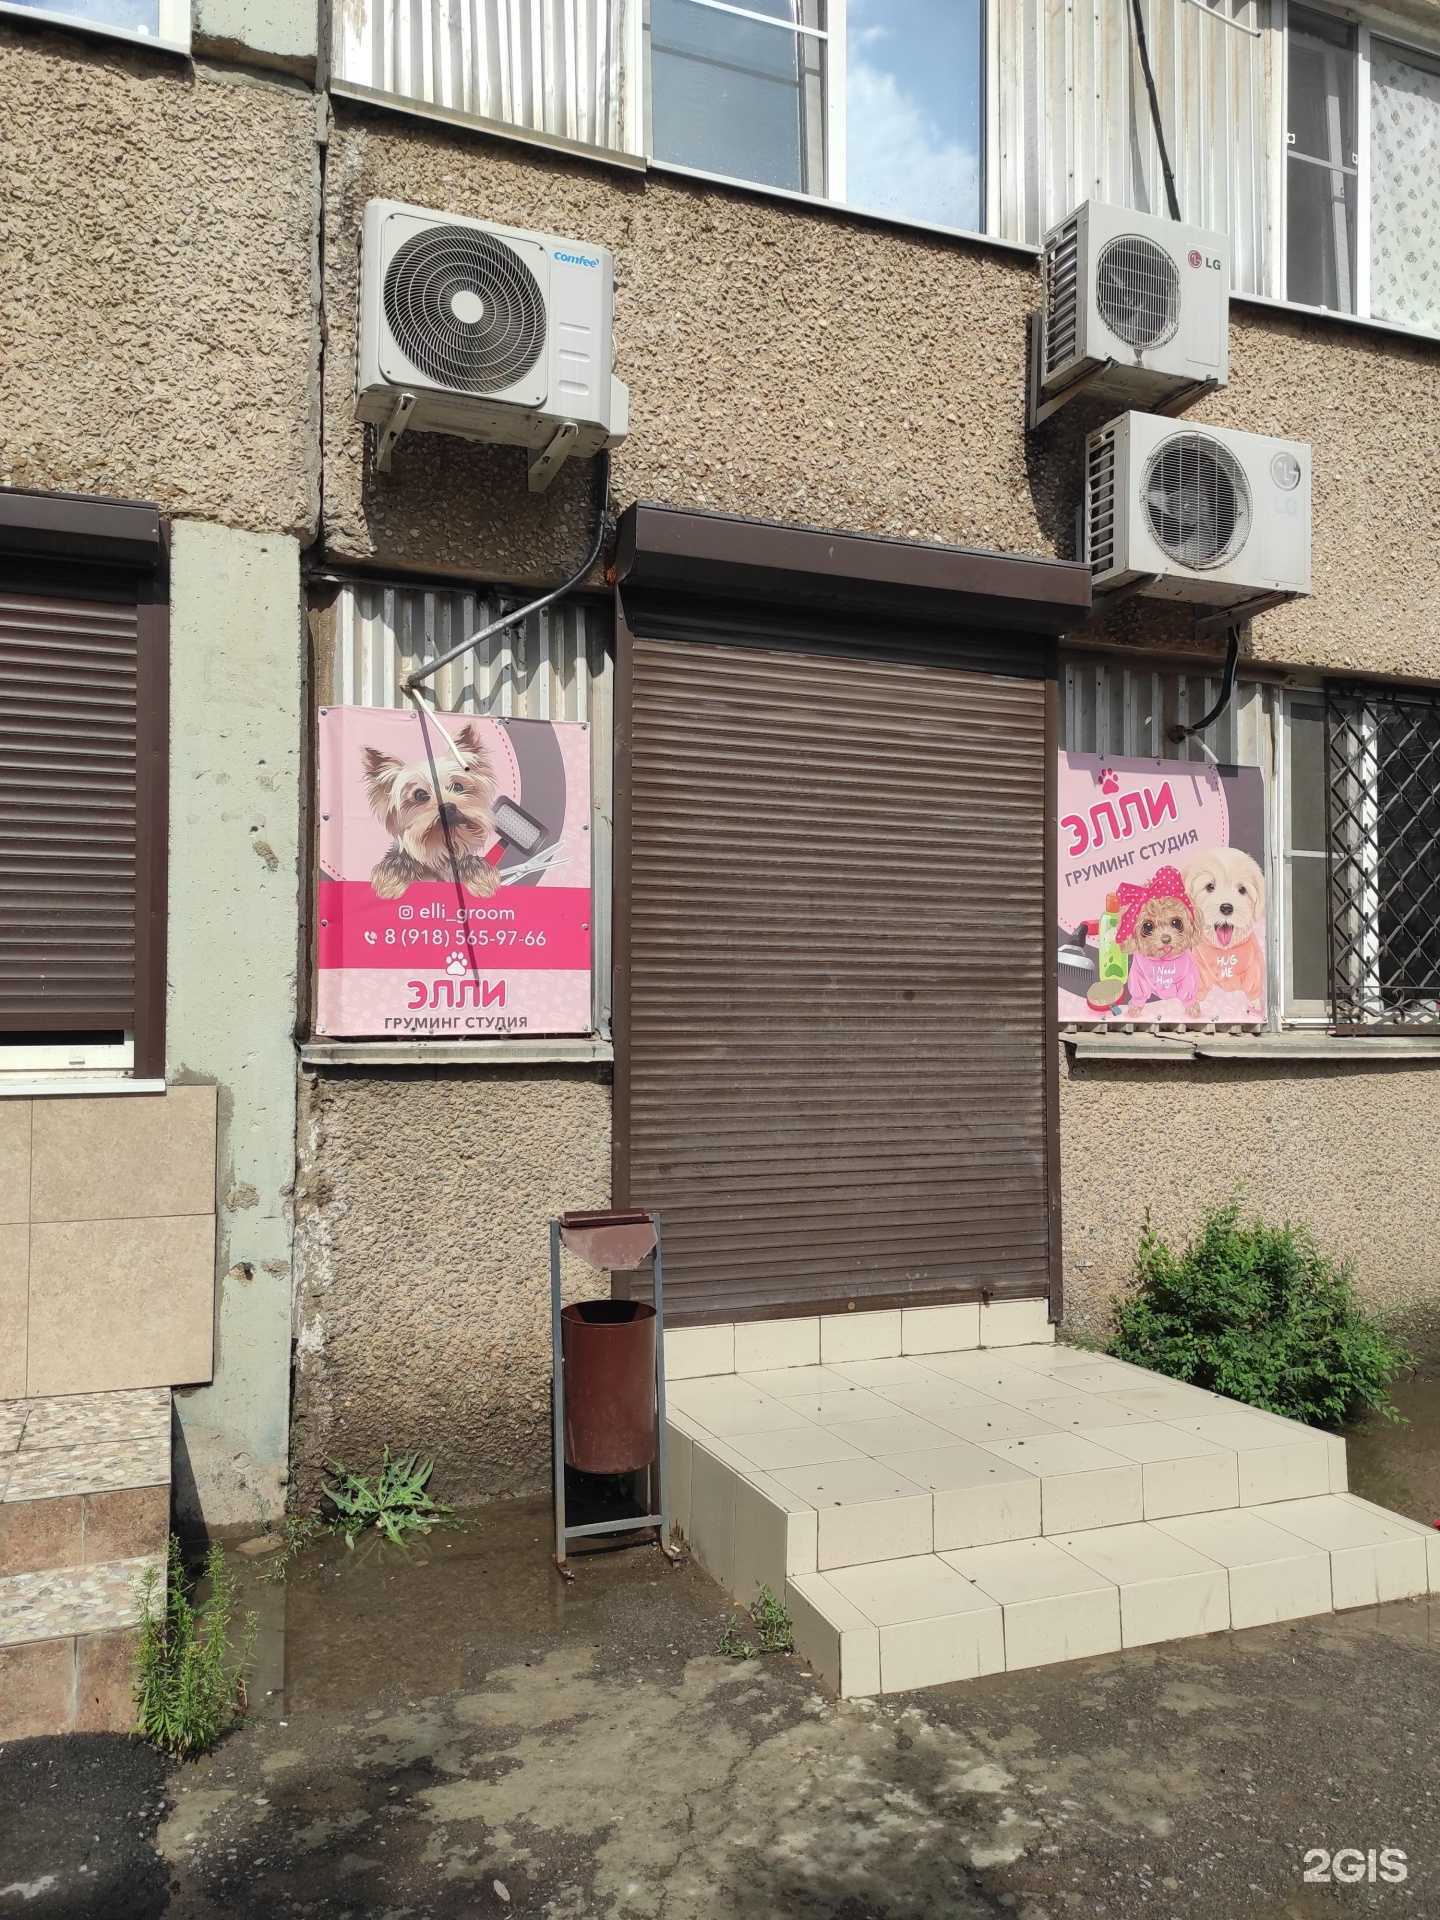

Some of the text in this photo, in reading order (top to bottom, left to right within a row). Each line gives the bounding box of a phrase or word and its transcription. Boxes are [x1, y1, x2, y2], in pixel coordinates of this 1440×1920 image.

[1205, 257, 1221, 270] LG
[1060, 781, 1178, 857] ЭЛЛИ
[1064, 829, 1199, 888] ГРУМИНГ СТУДИЯ
[419, 902, 515, 924] elli_groom
[384, 928, 547, 947] 8 (918) 565-97-66
[407, 979, 507, 1010] ЭЛЛИ
[384, 1016, 528, 1030] ГРУМИНГ СТУДИЯ
